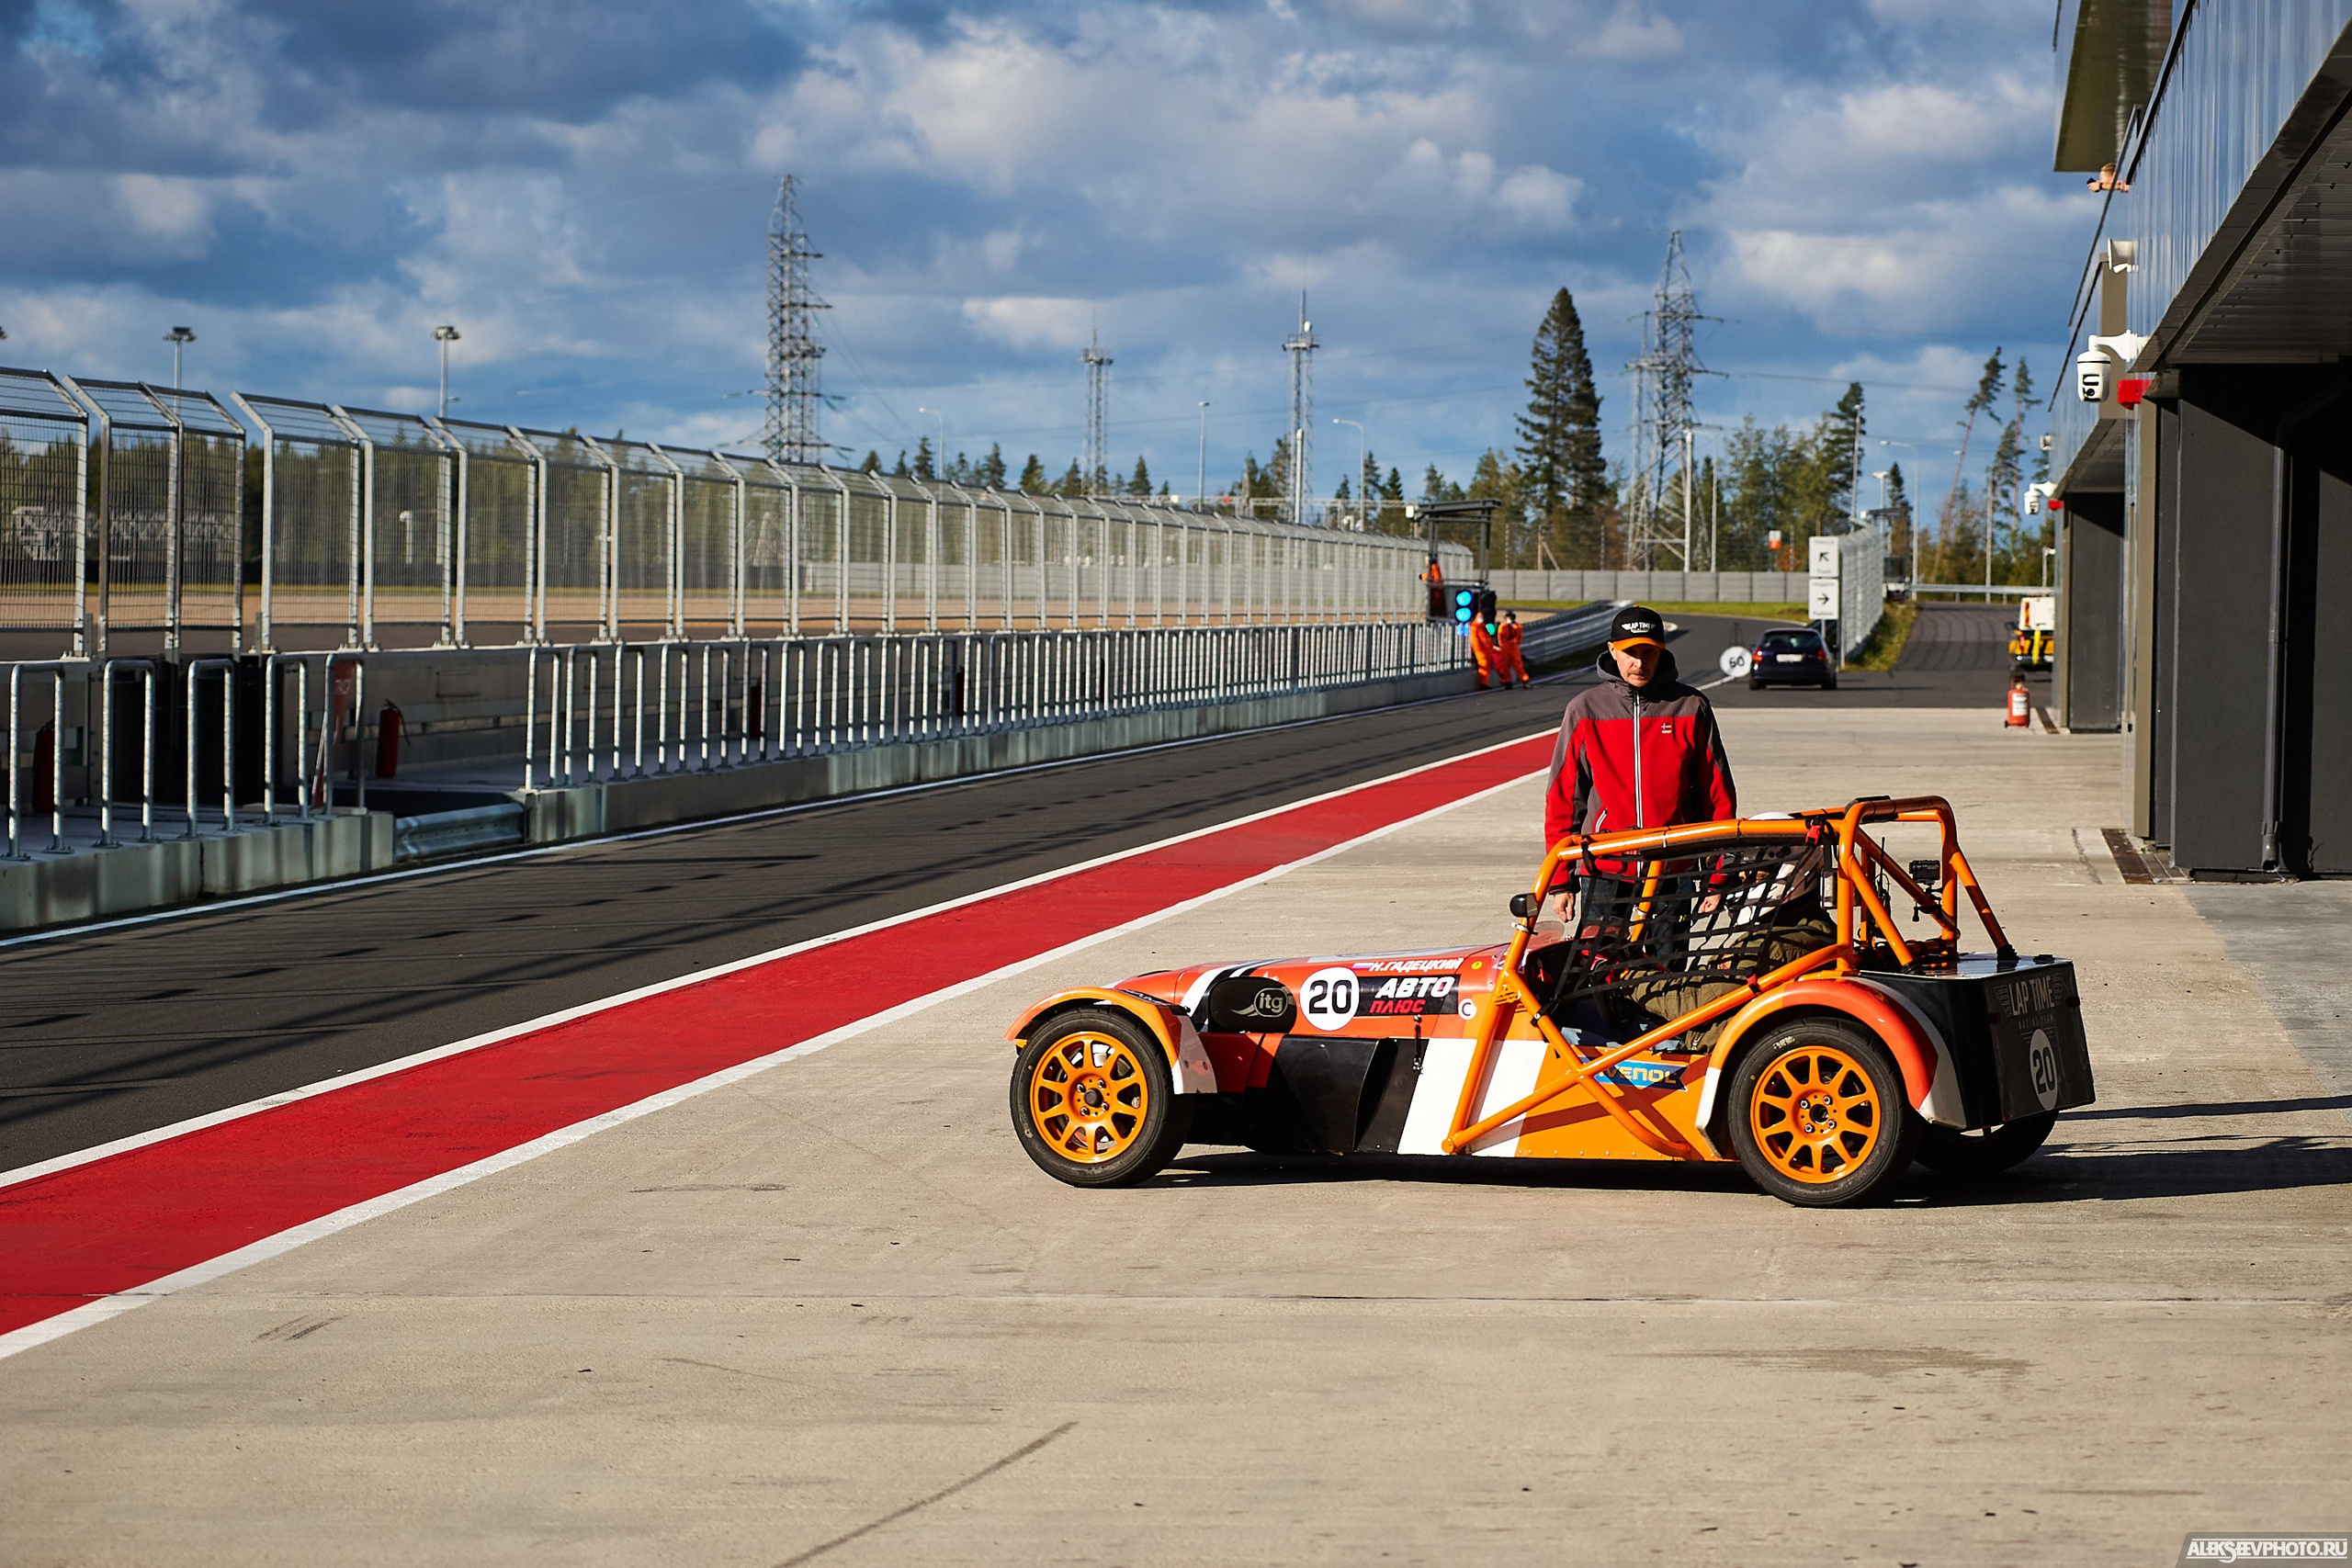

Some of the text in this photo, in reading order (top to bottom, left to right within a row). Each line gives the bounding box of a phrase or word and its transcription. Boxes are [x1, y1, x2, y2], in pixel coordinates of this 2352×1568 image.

[1729, 655, 1745, 669] 60
[1369, 957, 1464, 973] Н.ГАДЕЦКИЙ
[1308, 979, 1352, 1014] 20
[1374, 976, 1455, 999] АВТО
[2008, 975, 2055, 1017] LAP TIME
[1259, 992, 1283, 1013] itg
[1369, 998, 1427, 1014] ПЛЮС
[1461, 1001, 1472, 1017] C
[1599, 1066, 1677, 1084] VENOL
[2032, 1046, 2056, 1094] 20
